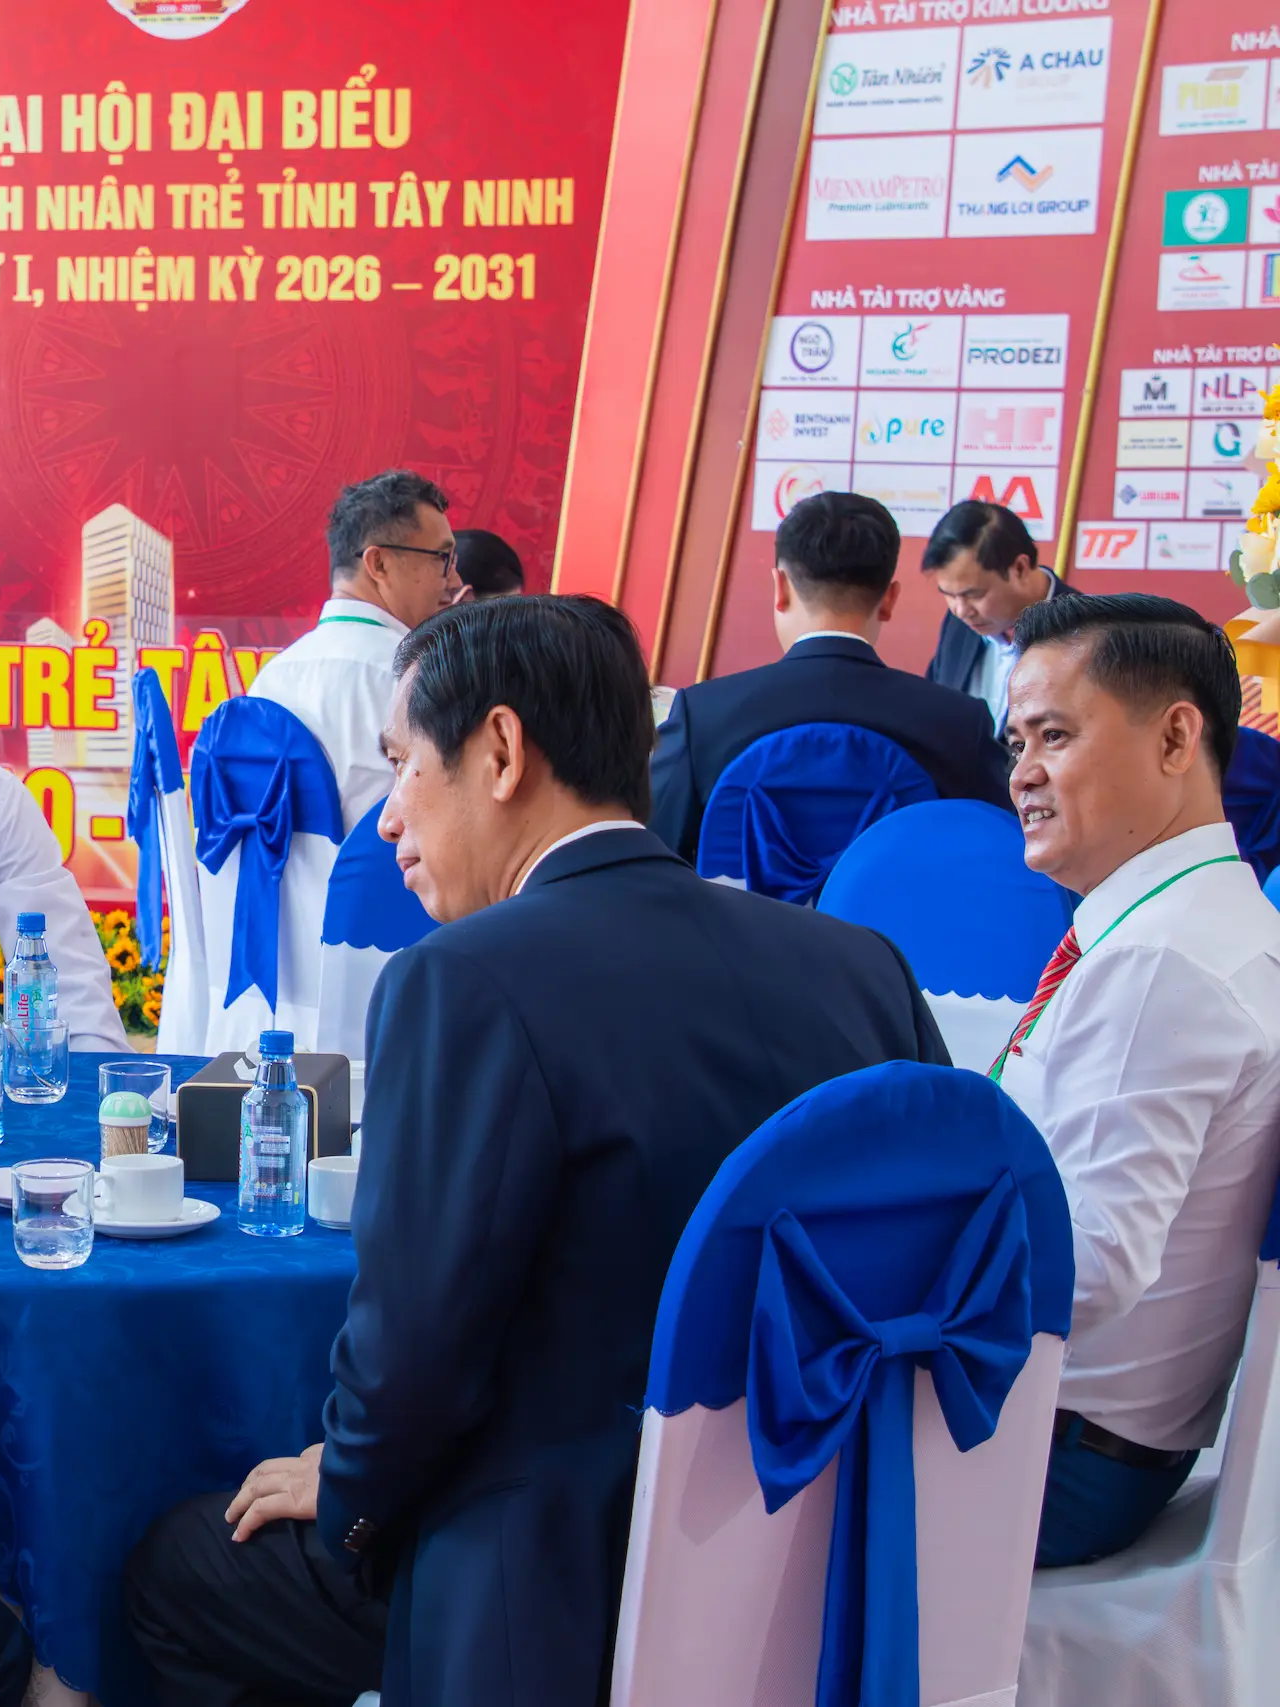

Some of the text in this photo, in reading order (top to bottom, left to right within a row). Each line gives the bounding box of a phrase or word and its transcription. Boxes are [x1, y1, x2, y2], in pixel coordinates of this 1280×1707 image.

[1020, 49, 1103, 70] A CHAU
[61, 80, 152, 165] HỘI
[168, 90, 263, 164] ĐẠI
[281, 63, 411, 150] BIỂU
[36, 175, 154, 230] NHÂN
[167, 168, 244, 230] TRẺ
[257, 167, 356, 229] TỈNH
[369, 171, 451, 228] TÂY
[463, 178, 574, 227] NINH
[1037, 200, 1091, 214] GROUP
[13, 254, 44, 307] I,
[57, 246, 195, 311] NHIỆM
[209, 245, 264, 302] KỲ
[275, 255, 381, 302] 2026
[433, 253, 536, 301] 2031
[967, 347, 1061, 365] PRODEZI
[17, 993, 29, 1017] Life
